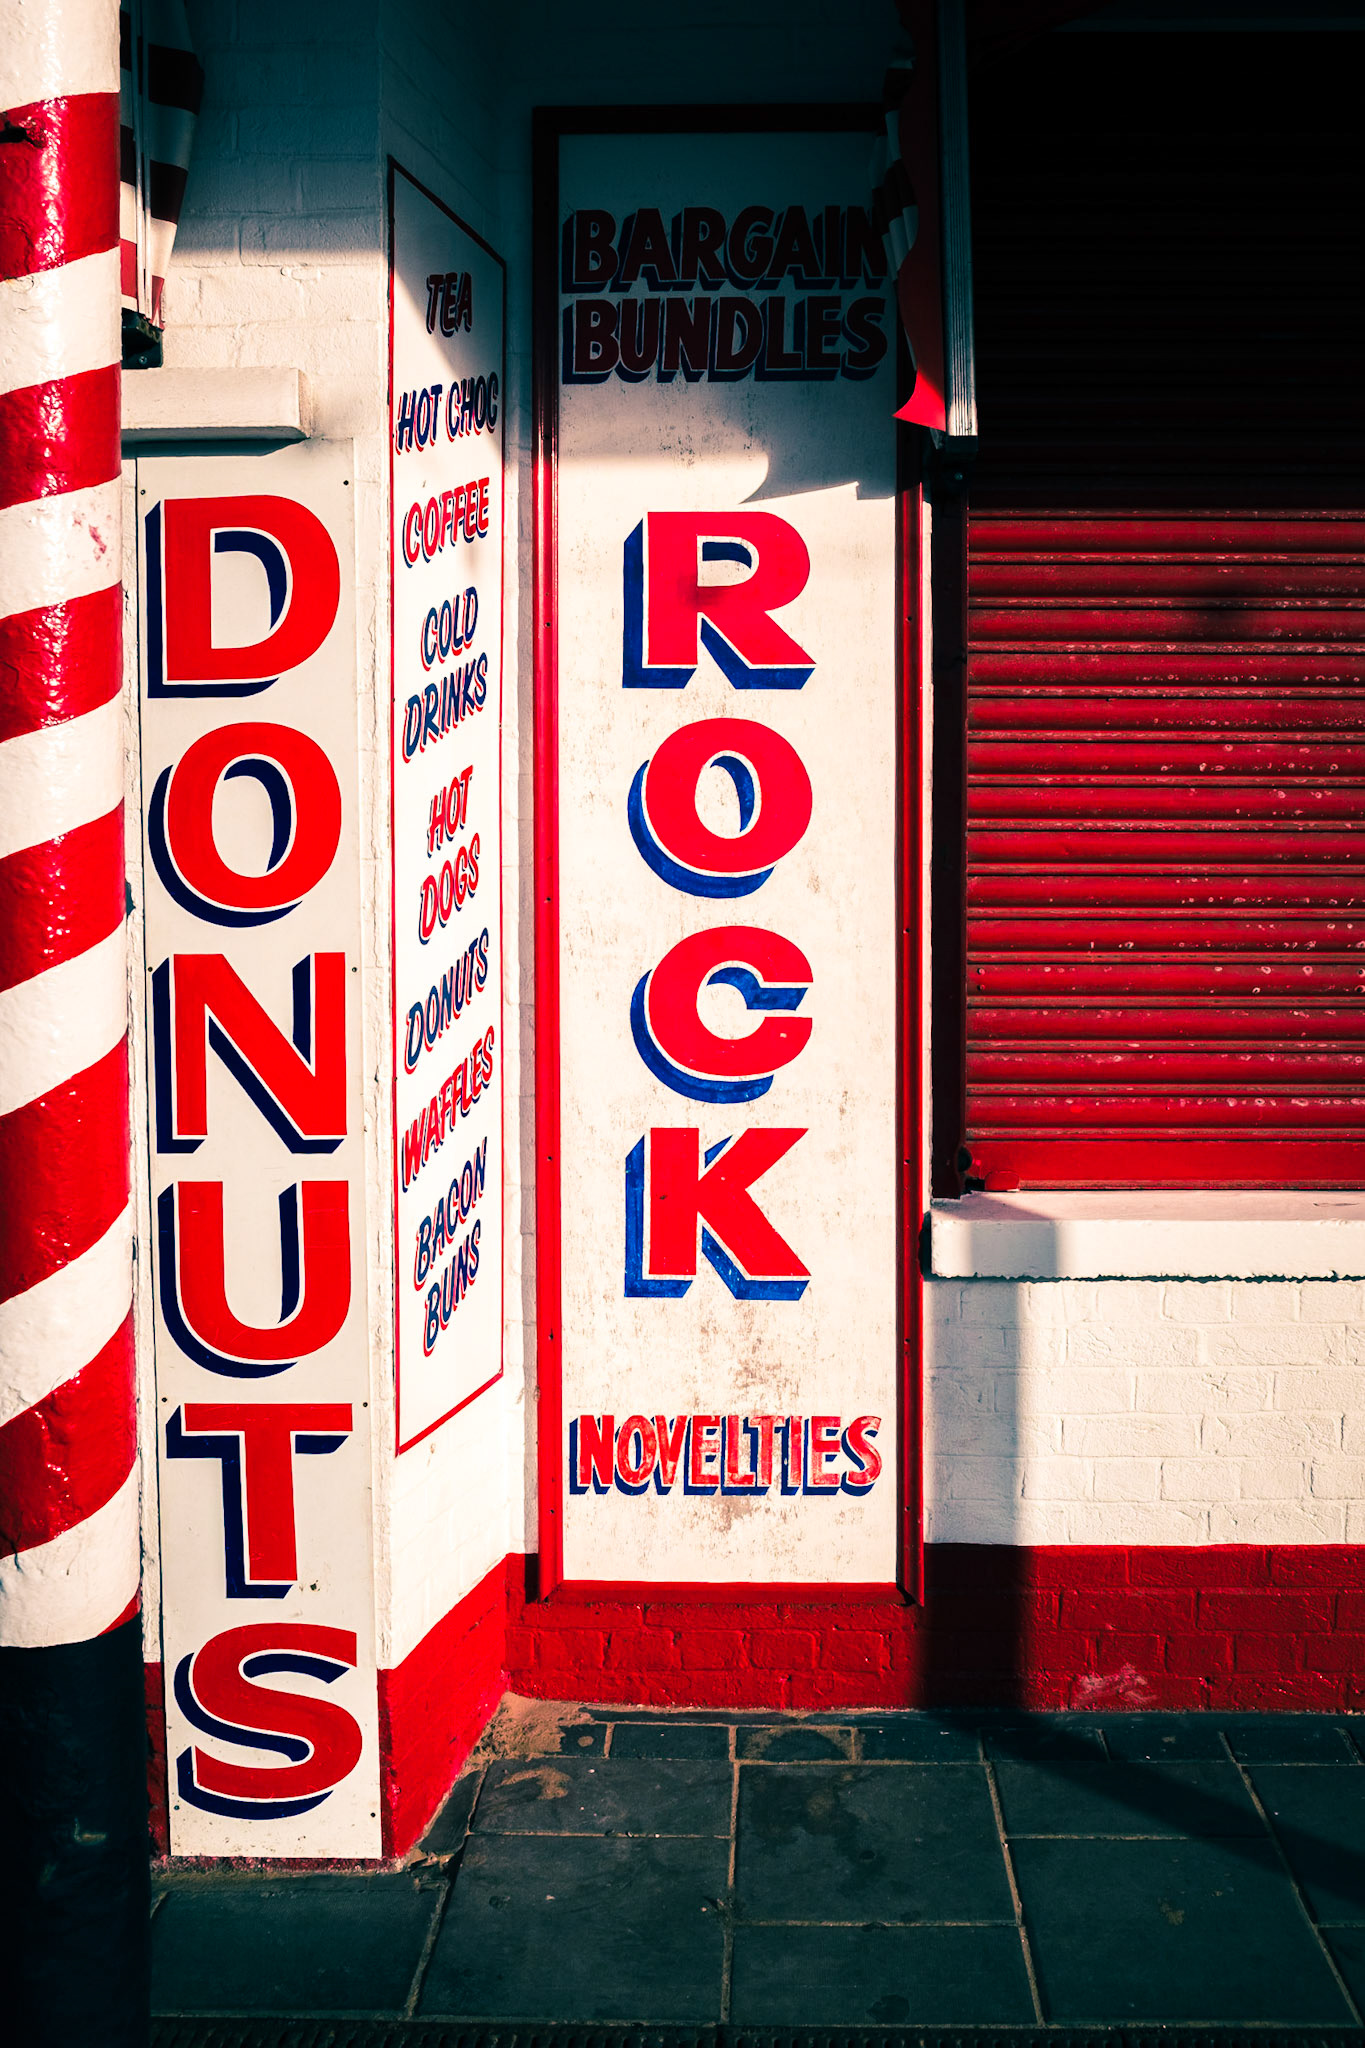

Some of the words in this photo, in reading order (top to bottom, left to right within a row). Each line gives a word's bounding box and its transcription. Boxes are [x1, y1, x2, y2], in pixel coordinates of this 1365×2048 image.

[562, 205, 888, 293] BARGAIN
[426, 272, 473, 335] TEA
[562, 296, 888, 385] BUNDLES
[395, 384, 442, 455] HOT
[446, 372, 498, 442] CHOC
[403, 477, 490, 568] COFFEE
[421, 586, 478, 671] COLD
[403, 653, 487, 763] DRINKS
[428, 766, 473, 858] HOT
[419, 833, 480, 943] DOGS
[623, 511, 814, 1301] ROCK
[405, 928, 489, 1074] DONUTS
[147, 496, 362, 1817] DONUTS
[402, 1026, 494, 1192] WAFFLES
[415, 1137, 487, 1290] BACON
[424, 1220, 481, 1357] BUNS
[569, 1415, 882, 1496] NOVELTIES
